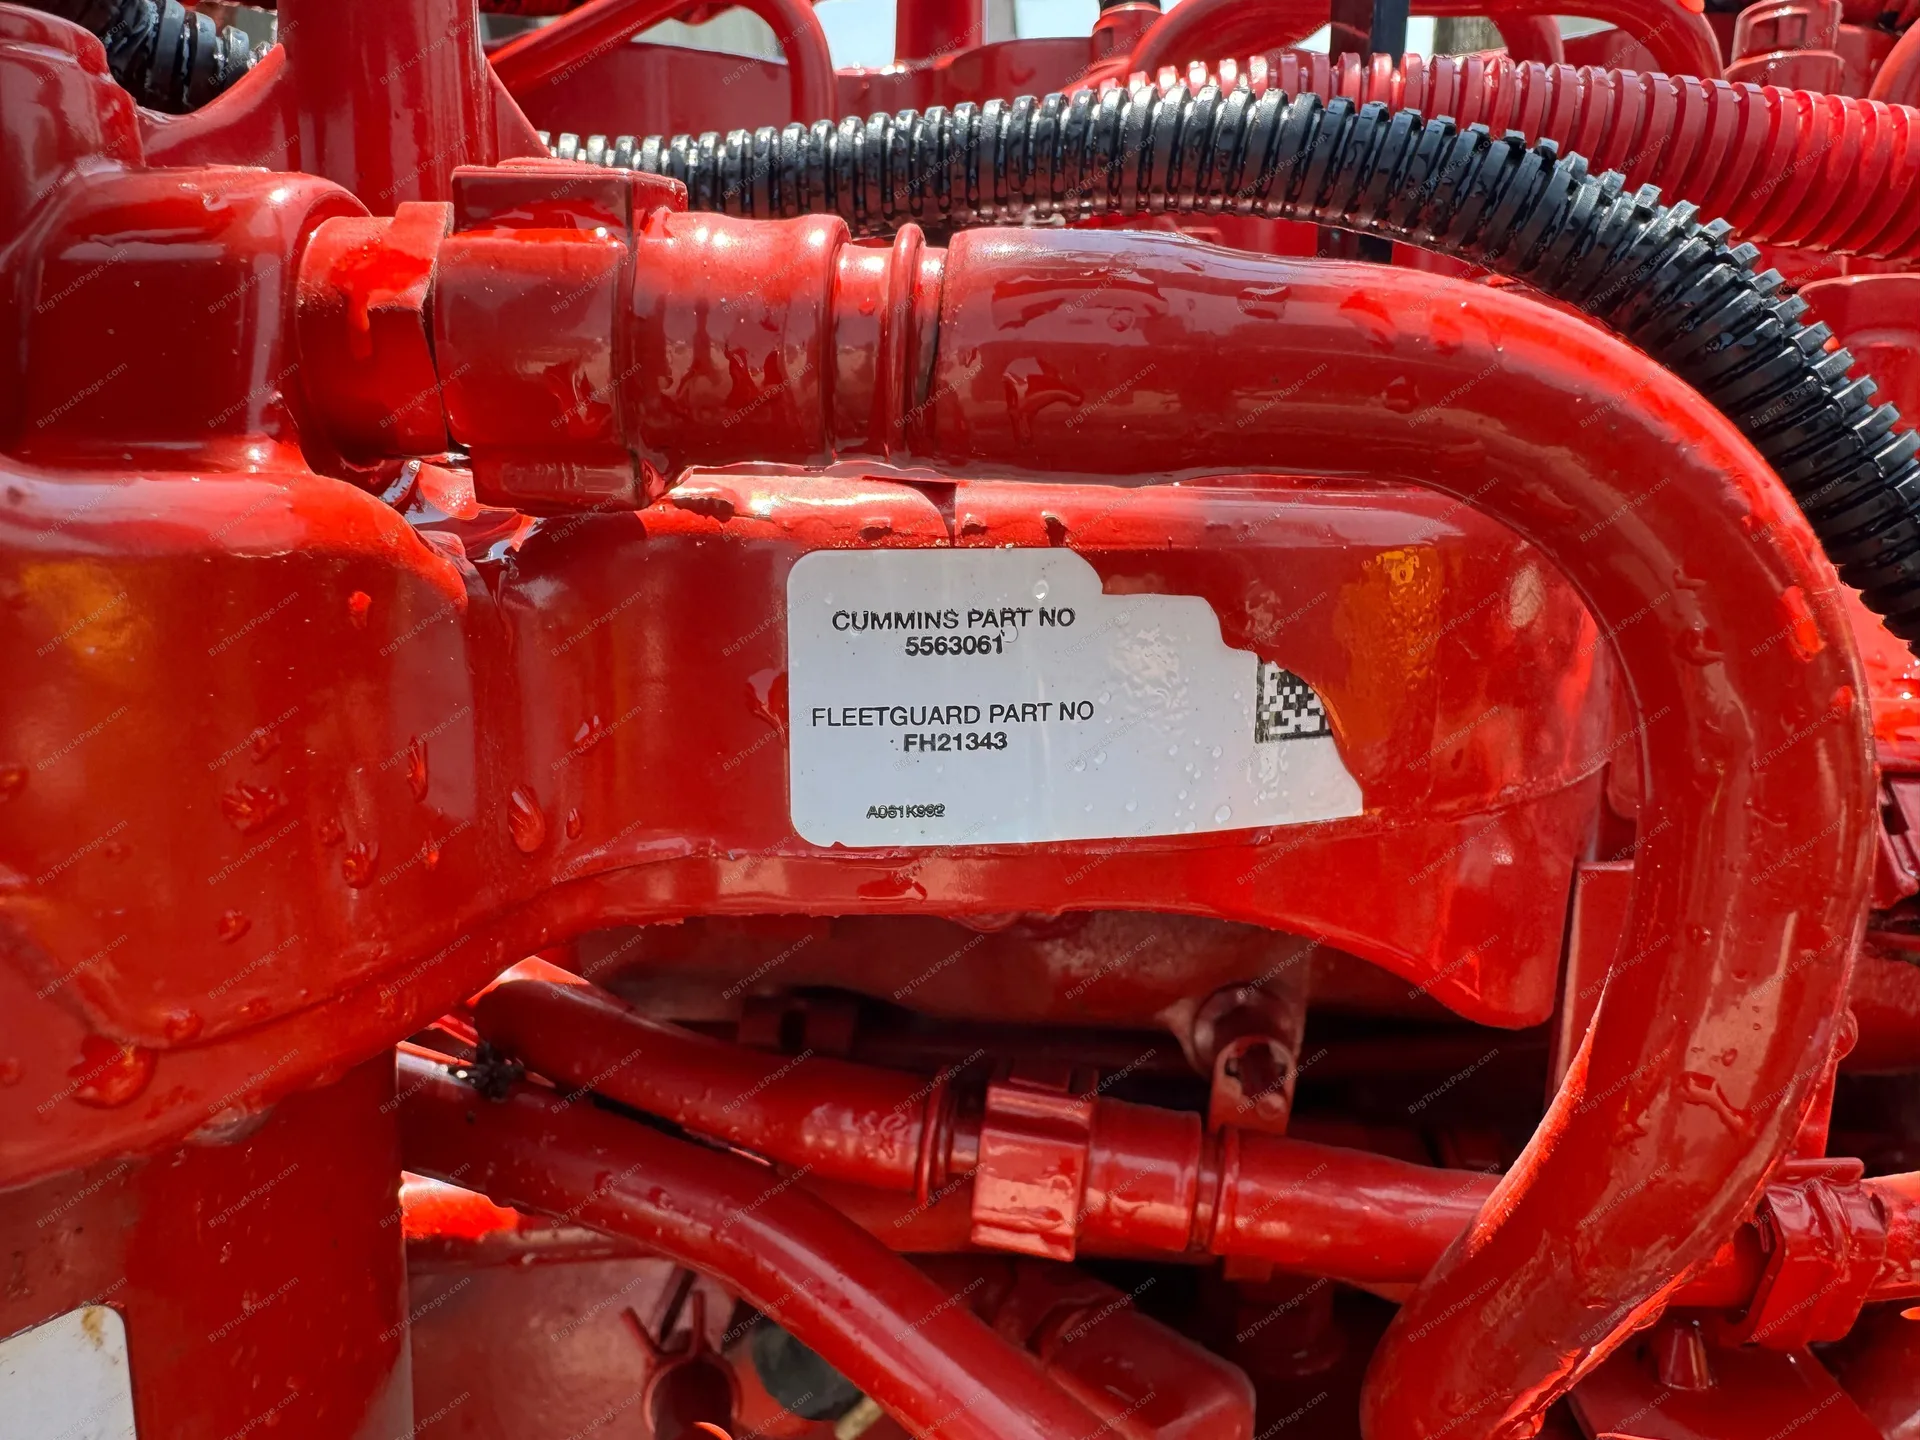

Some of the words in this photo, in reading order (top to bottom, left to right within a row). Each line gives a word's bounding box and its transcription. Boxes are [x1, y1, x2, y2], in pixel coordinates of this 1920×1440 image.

[832, 610, 960, 631] CUMMINS
[967, 607, 1033, 629] PART
[1039, 607, 1076, 627] NO
[905, 634, 1003, 656] 5563061
[811, 705, 981, 727] FLEETGUARD
[989, 703, 1053, 724] PART
[1059, 700, 1095, 721] NO
[903, 731, 1008, 752] FH21343
